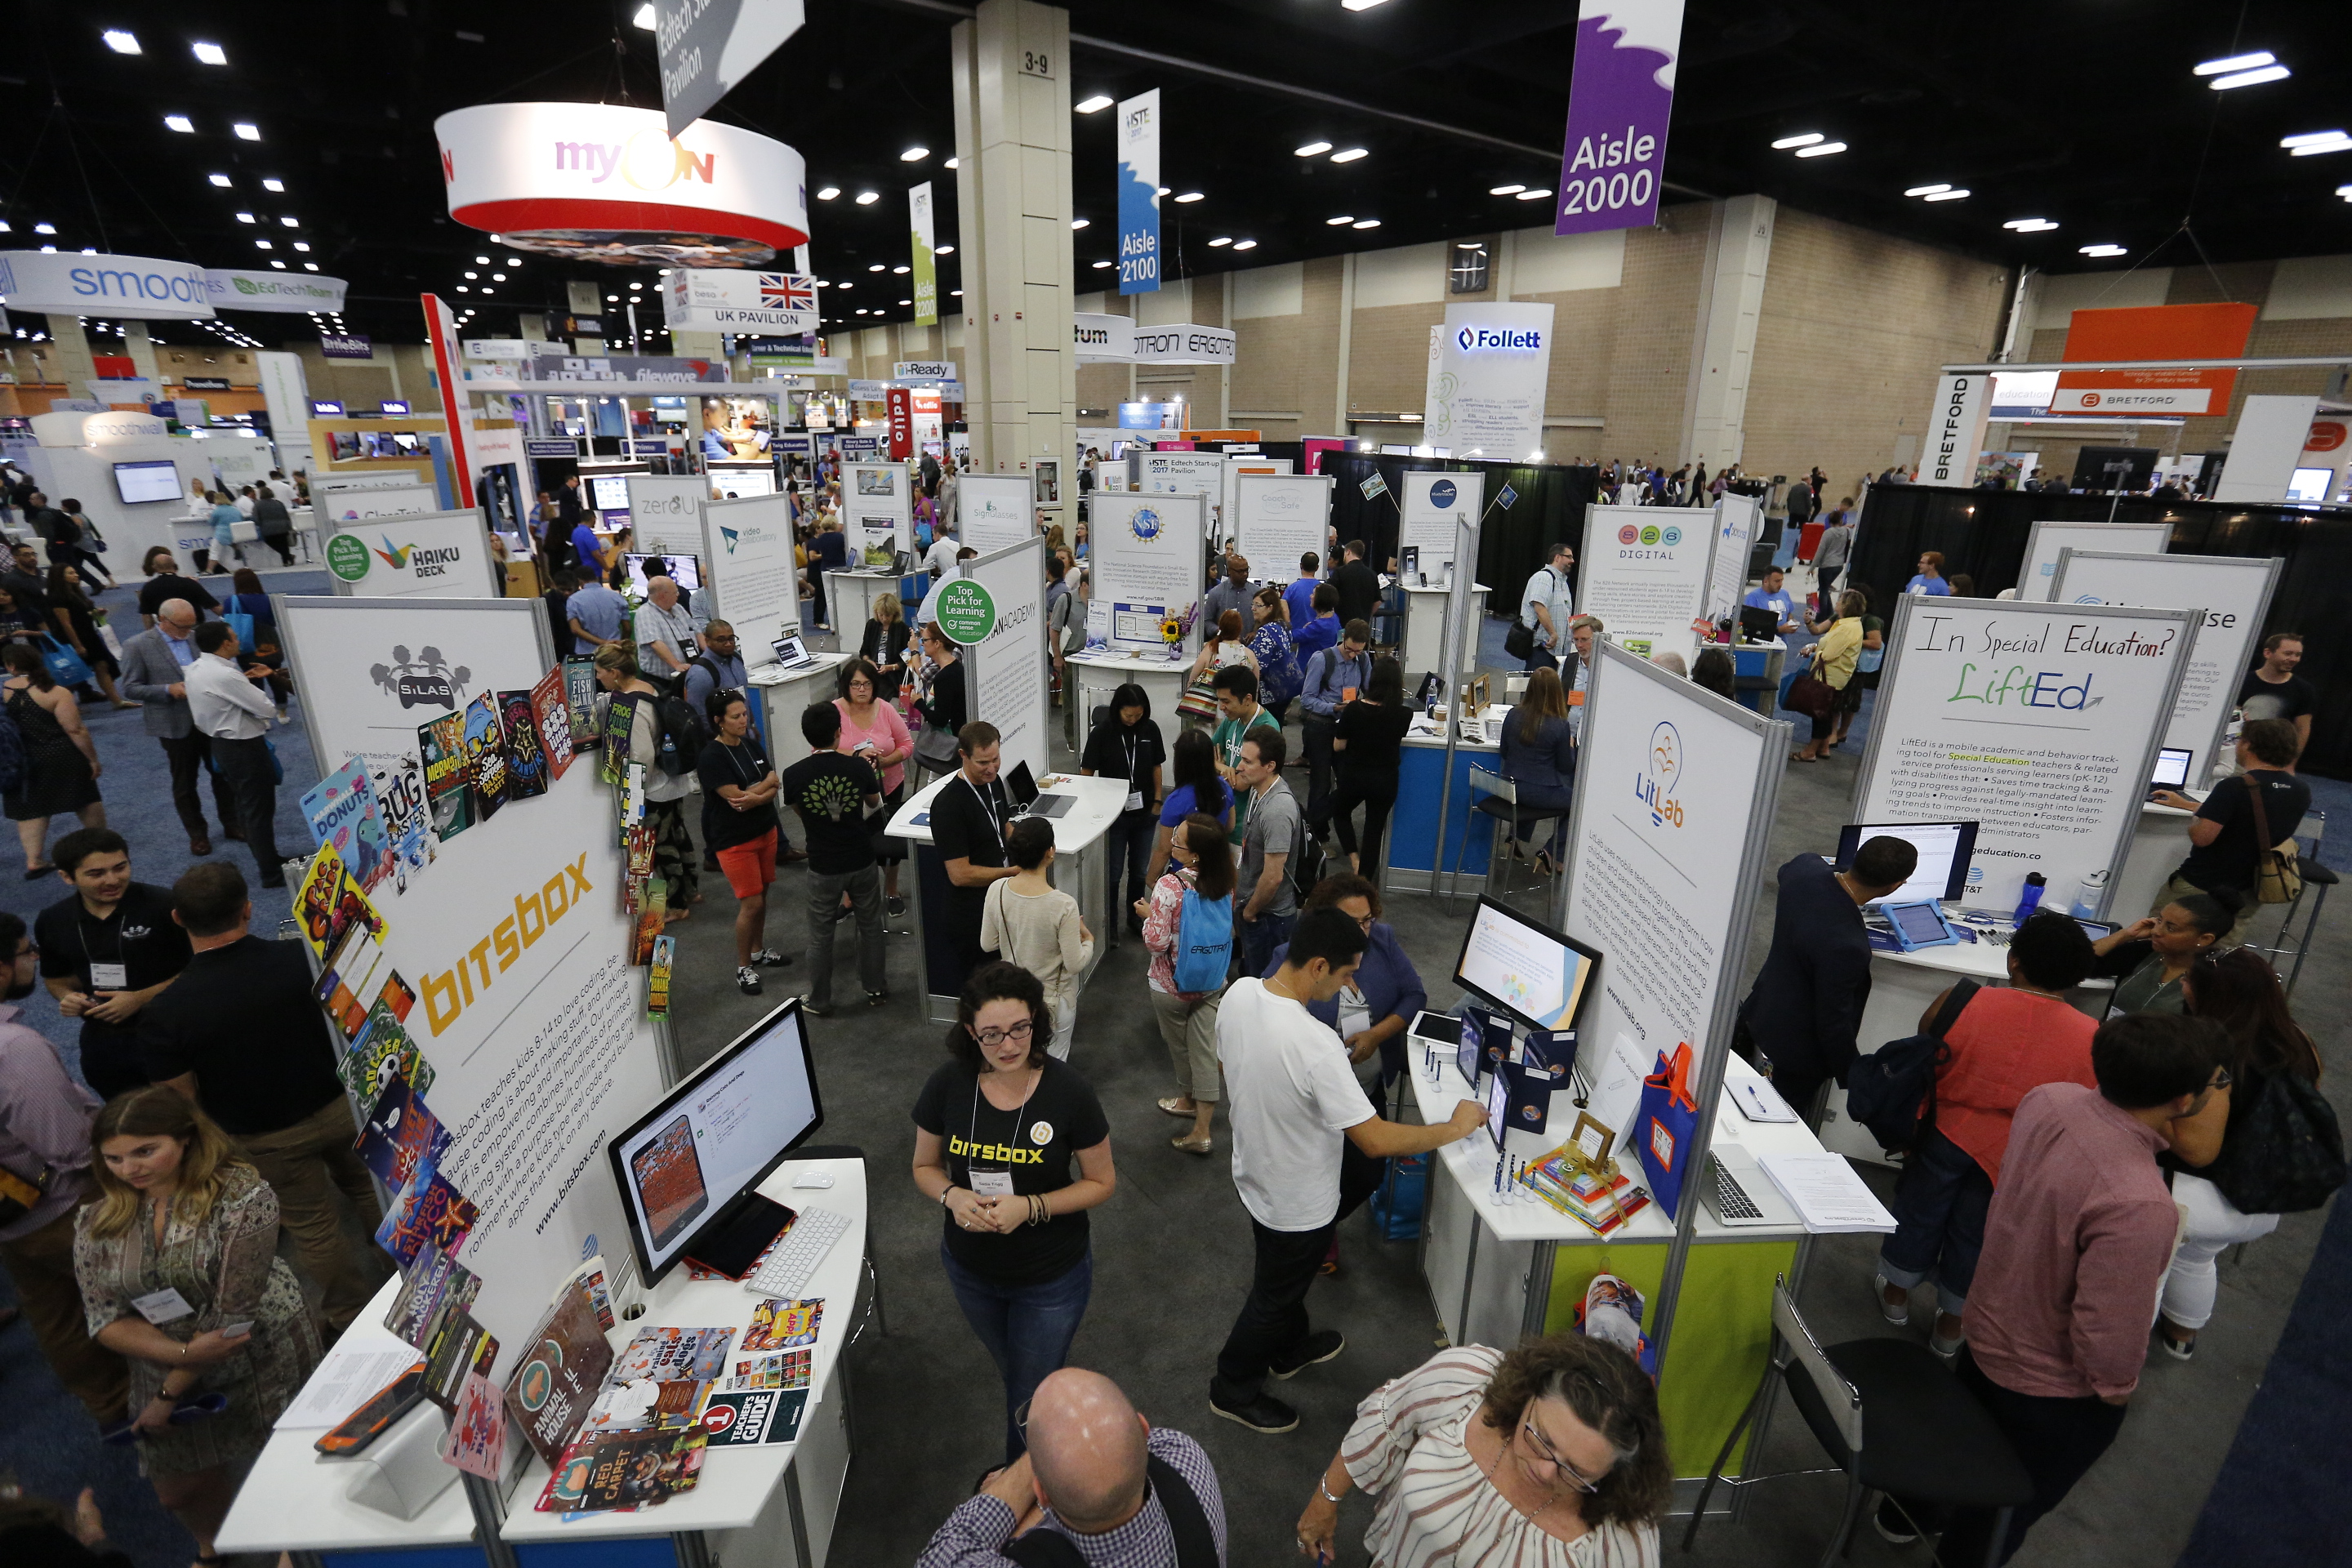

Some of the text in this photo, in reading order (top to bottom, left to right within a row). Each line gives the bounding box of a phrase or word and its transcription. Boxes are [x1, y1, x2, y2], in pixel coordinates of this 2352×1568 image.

[657, 2, 694, 59] Edtech
[1025, 51, 1049, 74] 3-9
[664, 47, 702, 104] Pavilion
[1570, 125, 1655, 173] Aisle
[1564, 168, 1652, 215] 2000
[1122, 232, 1155, 256] Aisle
[1122, 256, 1156, 283] 2100
[257, 282, 334, 299] EdTechTeam
[915, 281, 933, 299] Aisle
[715, 309, 799, 325] UK PAVILION
[915, 300, 934, 318] 2200
[1075, 325, 1107, 344] tum
[1477, 330, 1540, 349] Follett
[905, 364, 947, 377] i-Ready
[923, 400, 938, 409] edlio
[1999, 390, 2049, 399] education
[2107, 397, 2175, 405] BRETFORD
[2030, 408, 2047, 416] The
[1935, 377, 1967, 480] BRETFORD
[1195, 461, 1219, 469] Start-up
[974, 510, 1018, 520] SignGlasses
[1134, 516, 1160, 530] NSF
[739, 533, 777, 546] collaboratory
[743, 528, 760, 537] video
[333, 553, 364, 561] Learning
[412, 546, 460, 567] HAIKU
[1619, 550, 1674, 560] DIGITAL
[416, 565, 446, 577] DECK
[947, 595, 982, 607] Pick for
[956, 586, 973, 597] Top
[946, 605, 986, 618] Learning
[1915, 615, 2176, 659] In Special Education?
[572, 679, 591, 694] FISH
[1947, 662, 2093, 710] LiftEd
[572, 692, 592, 707] TANK
[612, 703, 632, 719] FROG
[2180, 698, 2207, 706] learning
[609, 714, 631, 730] PRINCE
[549, 724, 570, 751] little
[343, 750, 366, 759] We're
[555, 737, 572, 765] pigs
[1896, 750, 2119, 774] ing tool for Special Education teachers & related
[1900, 737, 1927, 747] LiftEd
[1928, 740, 1936, 748] is
[1945, 742, 1978, 752] mobile
[1980, 746, 2025, 755] academic
[2026, 749, 2046, 757] and
[2047, 750, 2091, 761] behavior
[2091, 755, 2118, 764] track-
[479, 756, 504, 785] Serpent
[482, 754, 497, 772] Sea
[483, 767, 506, 793] DANCE
[488, 777, 506, 797] PARTY
[317, 785, 369, 837] DONUTS
[1636, 773, 1684, 828] LitLab
[1971, 848, 2041, 860] geducation.co
[1588, 829, 1714, 956] LitLab uses mobile technology to transform how
[1964, 885, 1983, 894] T&T
[418, 850, 594, 1038] bitsbox
[1607, 985, 1646, 1040] www.litlab.org
[480, 1067, 516, 1113] teaches
[516, 1046, 535, 1071] kids
[534, 1021, 554, 1049] 8-14
[553, 1014, 563, 1028] to
[563, 995, 580, 1018] love
[580, 967, 607, 998] coding,
[607, 954, 619, 969] be-
[367, 1038, 400, 1096] SOCCER
[706, 1089, 721, 1103] Raining
[949, 1134, 1043, 1164] bitsbox
[536, 1129, 606, 1236] www.bitsbox.com
[402, 1184, 438, 1254] STARFISH
[410, 1187, 447, 1256] DISCO
[411, 1276, 430, 1316] HOLY
[411, 1257, 448, 1337] MACKEREL!
[652, 1340, 669, 1370] raining
[660, 1336, 682, 1366] cats
[672, 1336, 696, 1367] dogs
[533, 1388, 567, 1437] ANIMAL
[543, 1398, 572, 1446] HOUSE
[704, 1409, 729, 1427] 1
[731, 1395, 755, 1442] TEACHER'S
[742, 1393, 772, 1441] GUIDE
[594, 1463, 612, 1489] RED
[604, 1450, 630, 1501] CARPET
